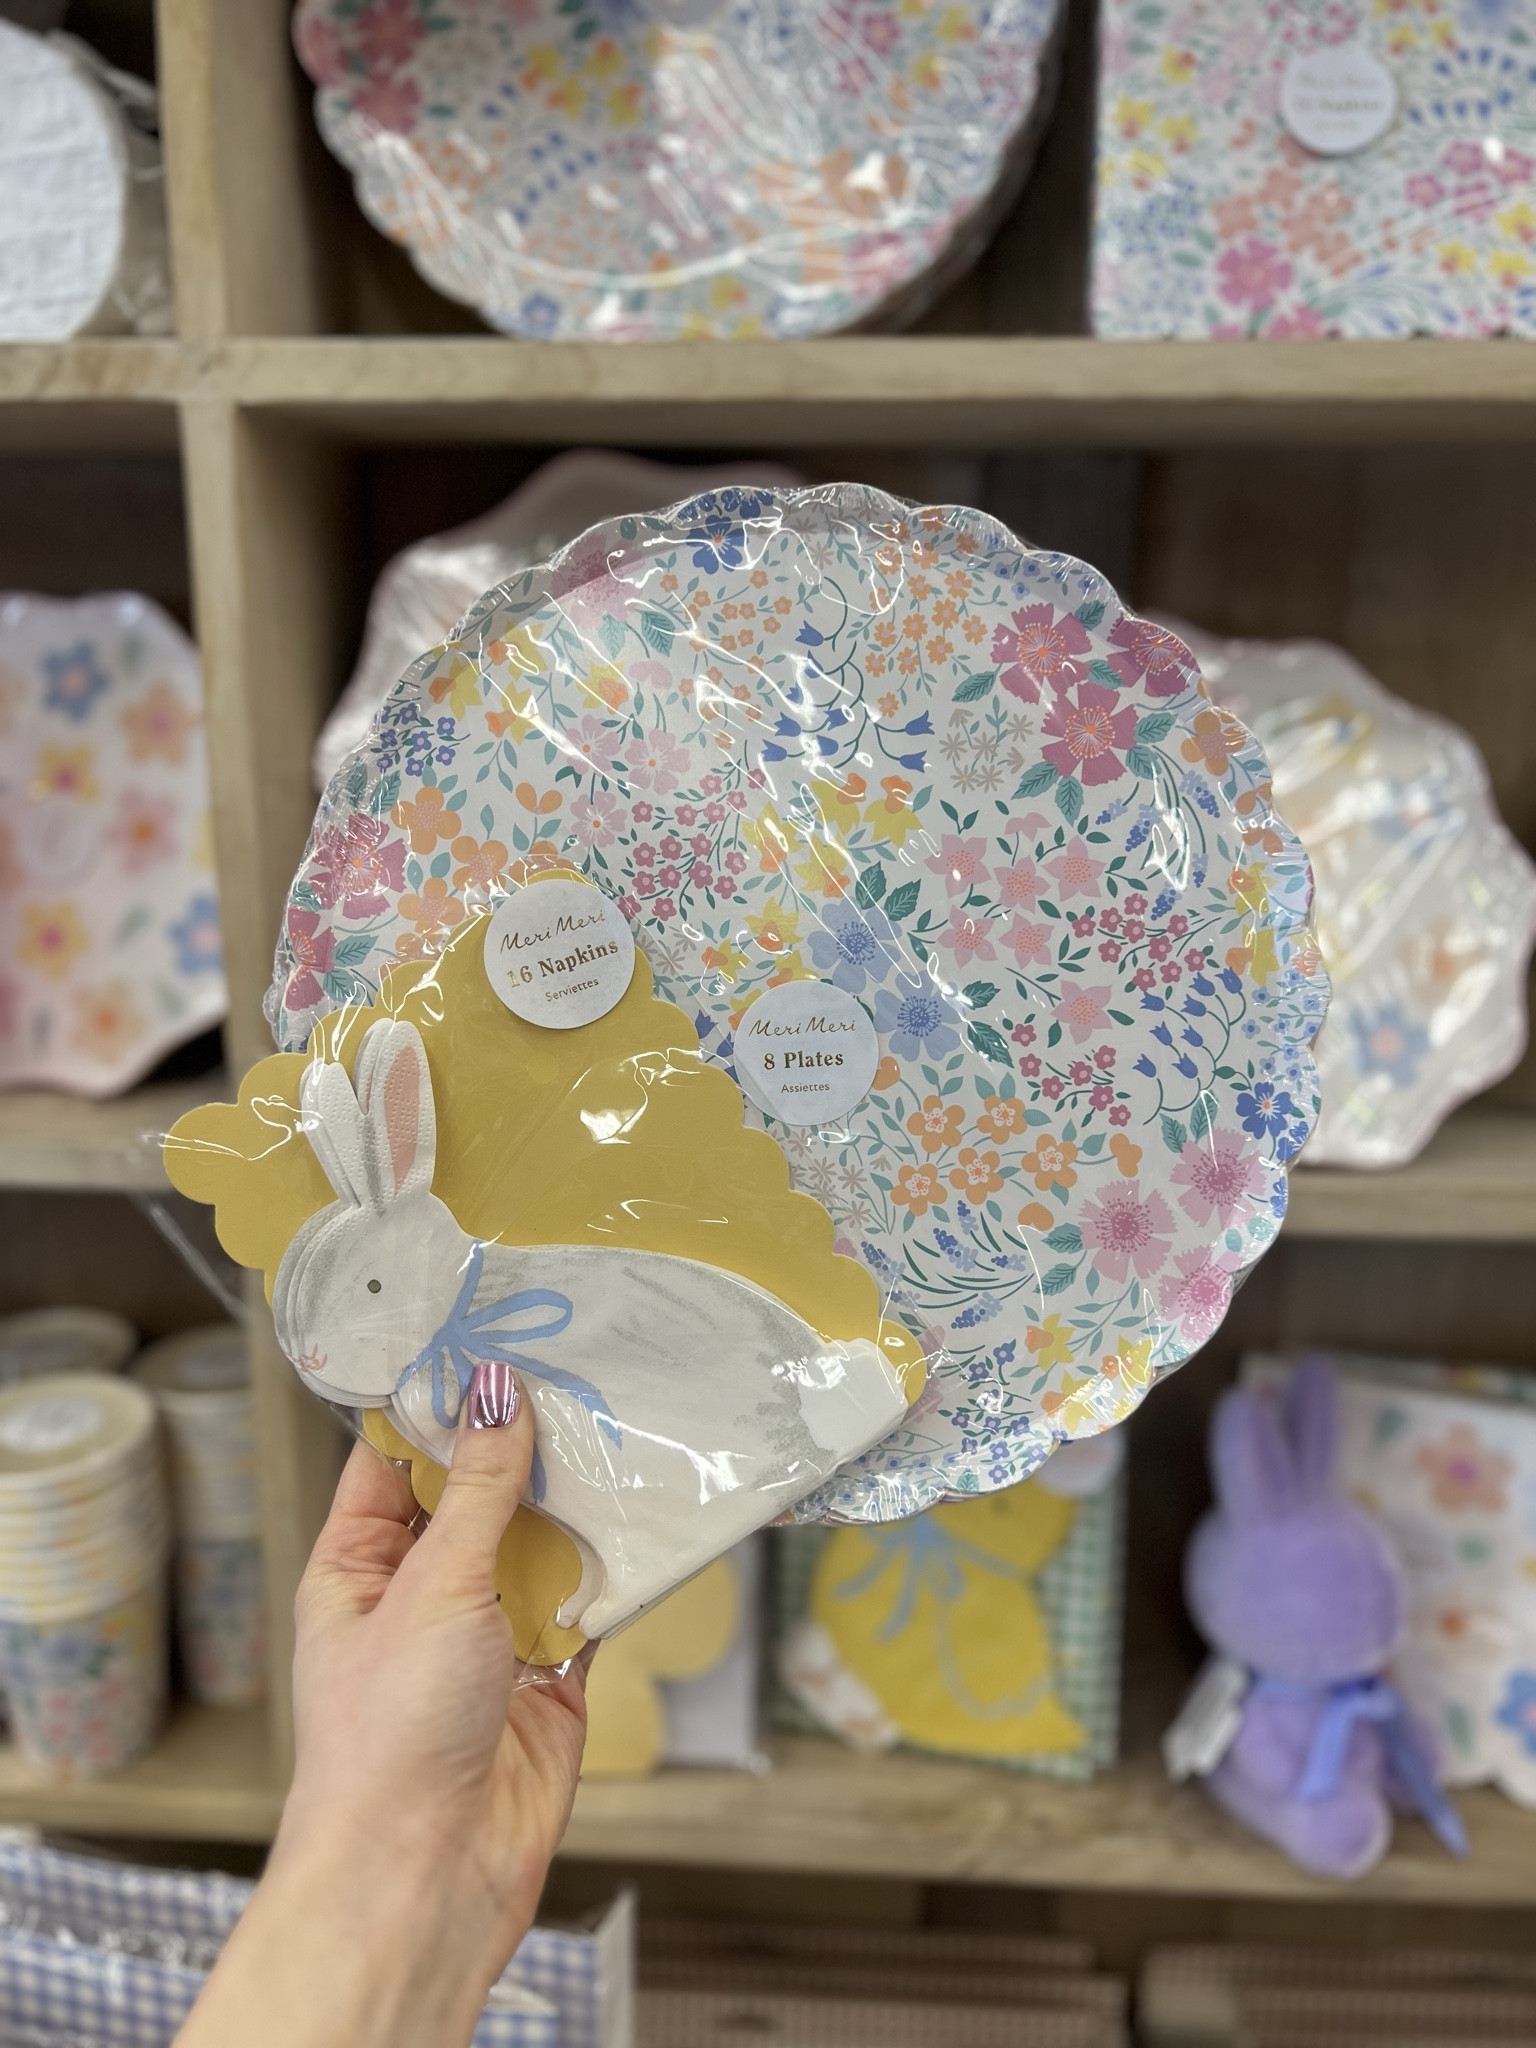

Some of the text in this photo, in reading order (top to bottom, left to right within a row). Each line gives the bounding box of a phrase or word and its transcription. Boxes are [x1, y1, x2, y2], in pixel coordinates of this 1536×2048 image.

[500, 910, 606, 953] Meri Meri
[507, 940, 619, 988] 16 Napkins
[545, 978, 599, 1002] Serviettes
[749, 1016, 856, 1037] Meri Meri
[764, 1051, 844, 1071] 8 Plates
[780, 1083, 830, 1094] Assiettes
